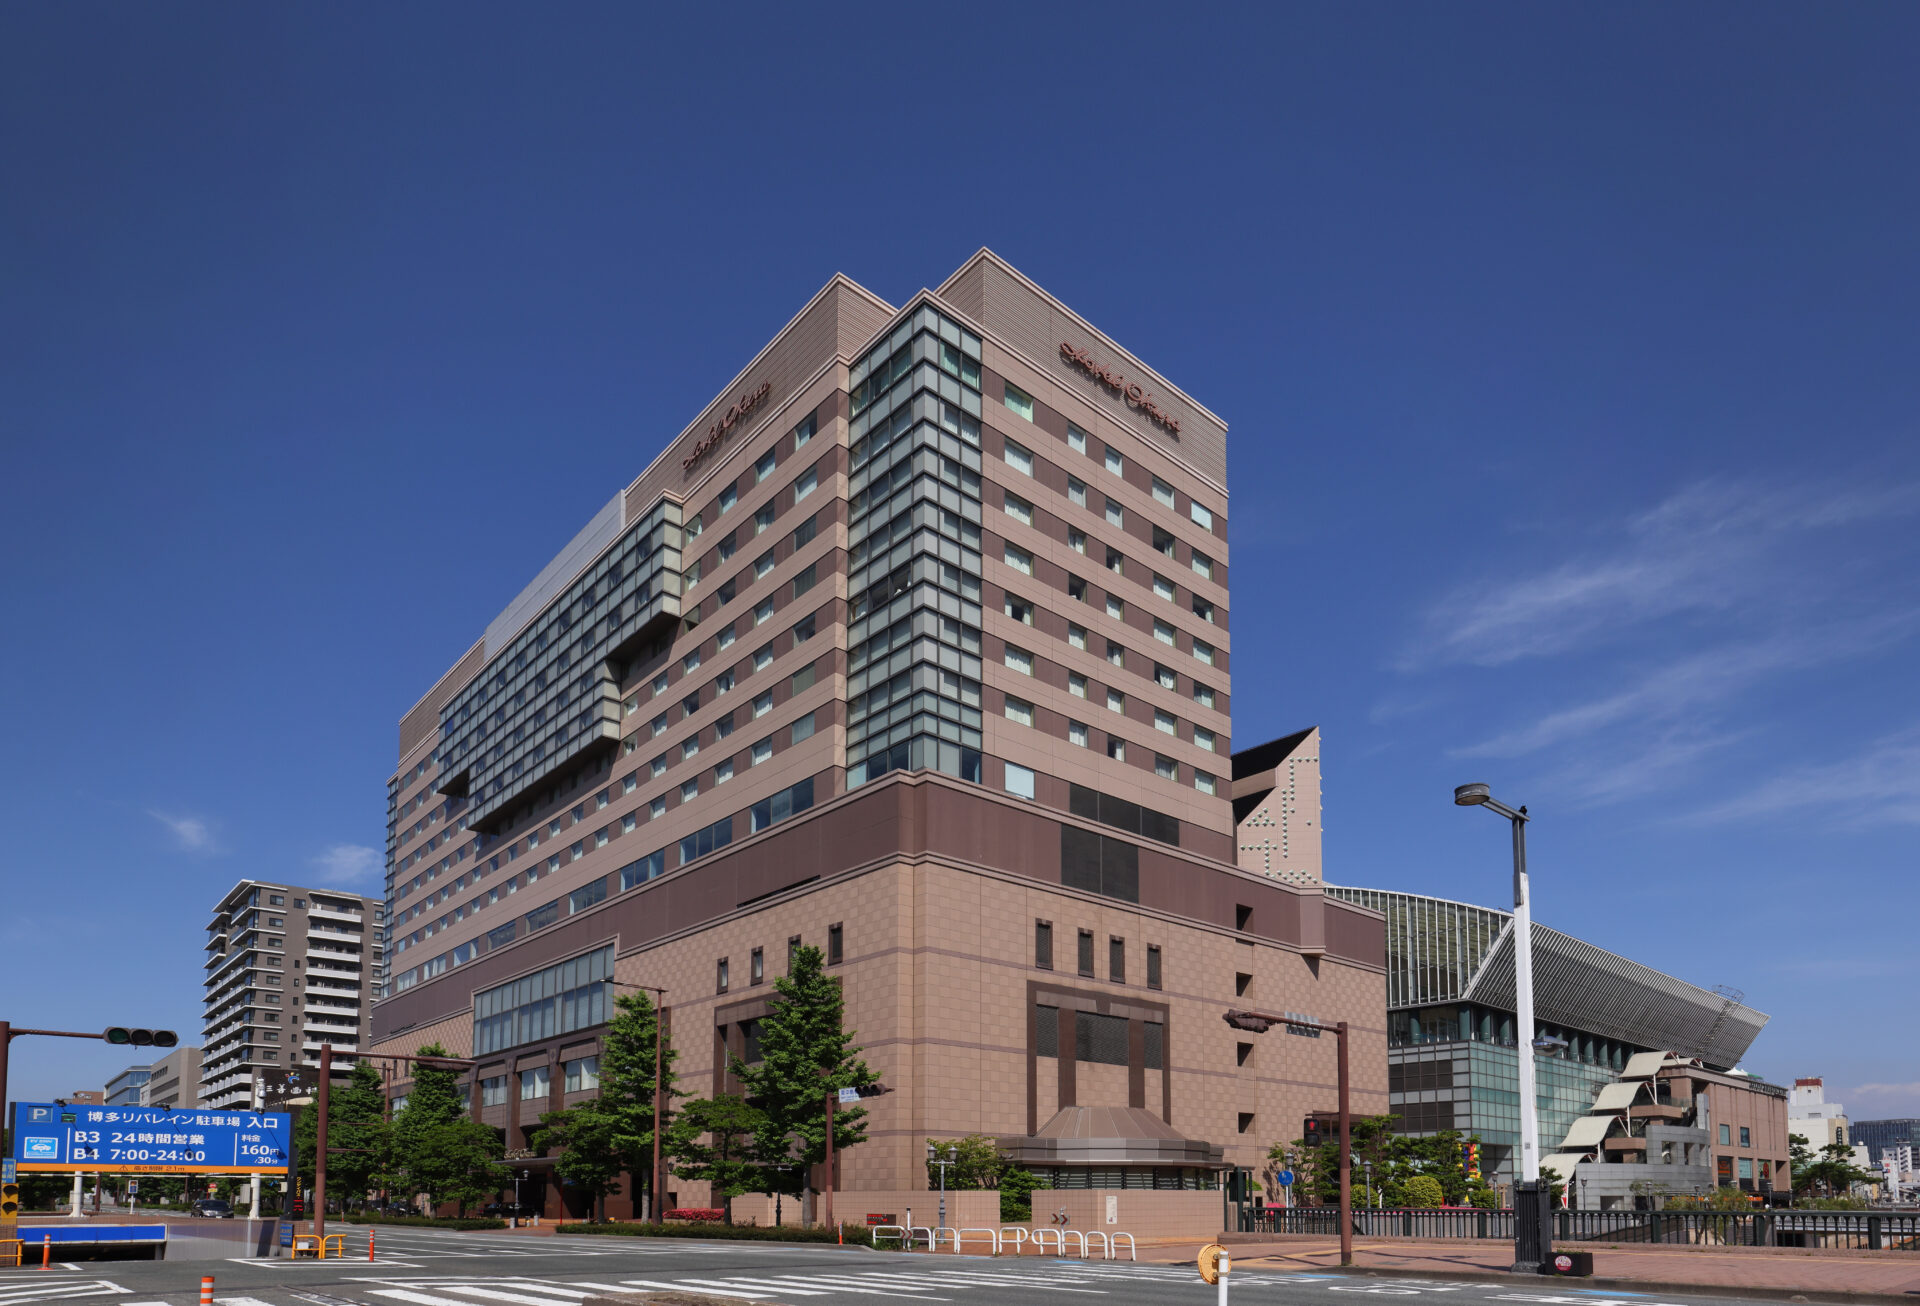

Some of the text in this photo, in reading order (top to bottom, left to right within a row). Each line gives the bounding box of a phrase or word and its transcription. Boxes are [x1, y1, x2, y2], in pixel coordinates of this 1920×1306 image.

[33, 1108, 48, 1120] P
[88, 1111, 240, 1126] 博多リバレイン駐車場
[247, 1117, 278, 1128] 入口
[74, 1131, 205, 1145] B3 24時間営業
[241, 1135, 261, 1143] 料金
[73, 1148, 206, 1161] B4 7:00-24:00
[241, 1145, 280, 1155] 160円
